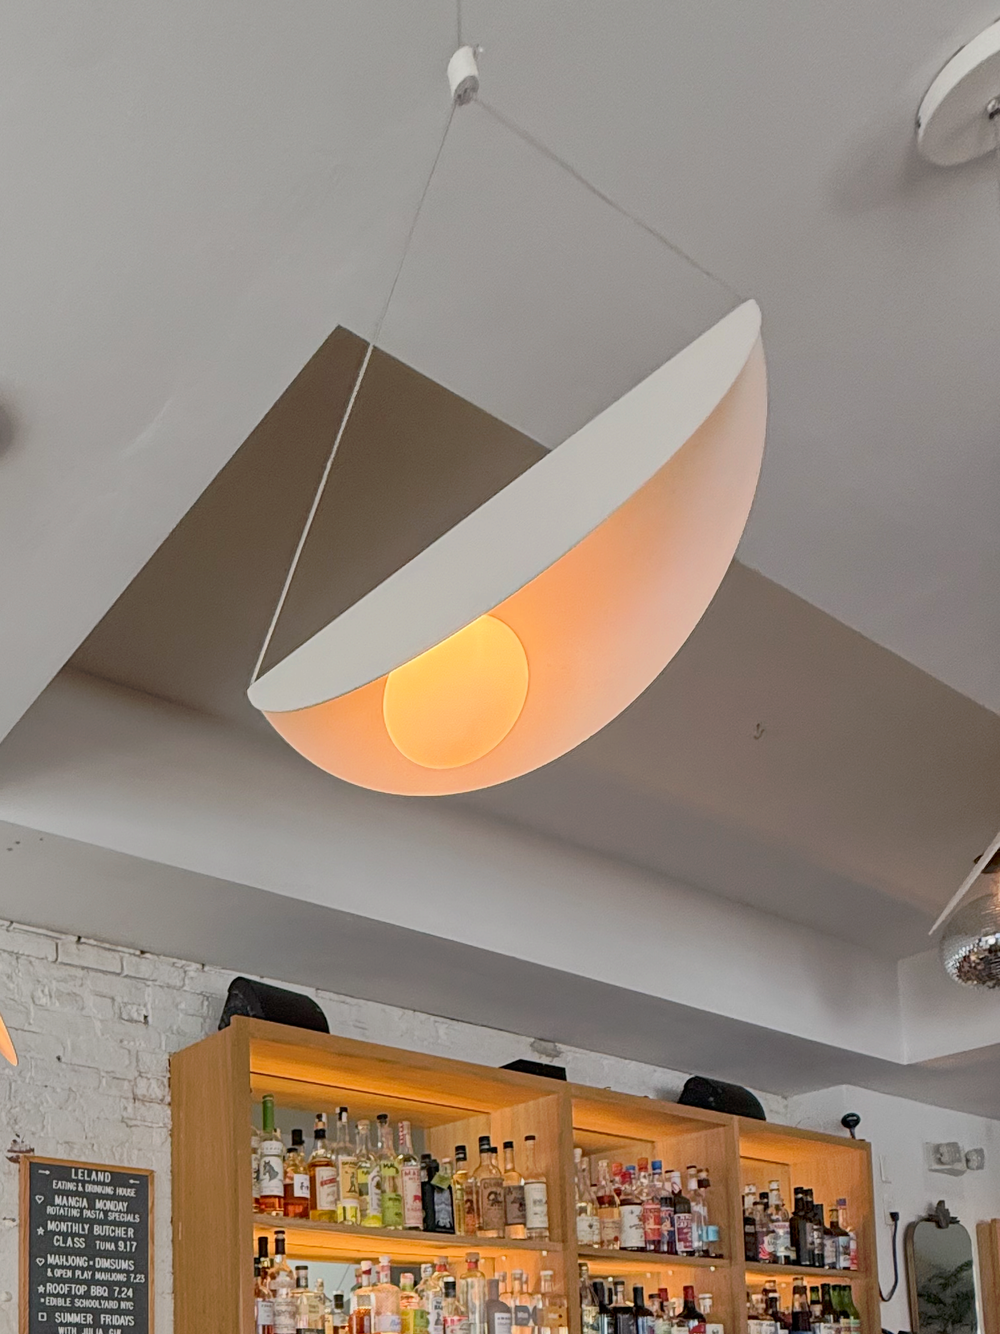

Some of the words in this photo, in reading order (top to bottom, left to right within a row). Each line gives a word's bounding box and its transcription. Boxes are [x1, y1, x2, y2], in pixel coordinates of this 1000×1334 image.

[71, 1168, 111, 1183] LELAND
[52, 1180, 76, 1191] EATING
[78, 1183, 83, 1192] &
[85, 1184, 114, 1195] DRINKING
[116, 1187, 136, 1197] HOUSE
[54, 1195, 88, 1208] MANGIA
[95, 1199, 128, 1212] MONDAY
[47, 1206, 80, 1218] ROTATING
[83, 1210, 104, 1220] PASTA
[108, 1212, 140, 1223] SPECIALS
[47, 1220, 89, 1235] MONTHLY
[93, 1224, 134, 1238] BUTCHER
[53, 1235, 85, 1248] CLASS
[95, 1240, 115, 1251] TUNA
[118, 1241, 137, 1252] 9.17
[47, 1254, 88, 1268] MAHJONG
[95, 1258, 134, 1271] DIMSUMS
[47, 1268, 53, 1278] &
[54, 1269, 72, 1279] OPEN
[75, 1271, 92, 1279] PLAY
[95, 1272, 127, 1282] MAHJONG
[46, 1283, 87, 1296] ROOFTOP
[90, 1285, 108, 1297] BBQ
[113, 1287, 134, 1298] 7.24
[46, 1297, 72, 1307] EDIBLE
[74, 1299, 118, 1309] SCHOOLYARD
[120, 1301, 134, 1310] NYC
[55, 1312, 93, 1324] SUMMER
[100, 1314, 135, 1326] FRIDAYS
